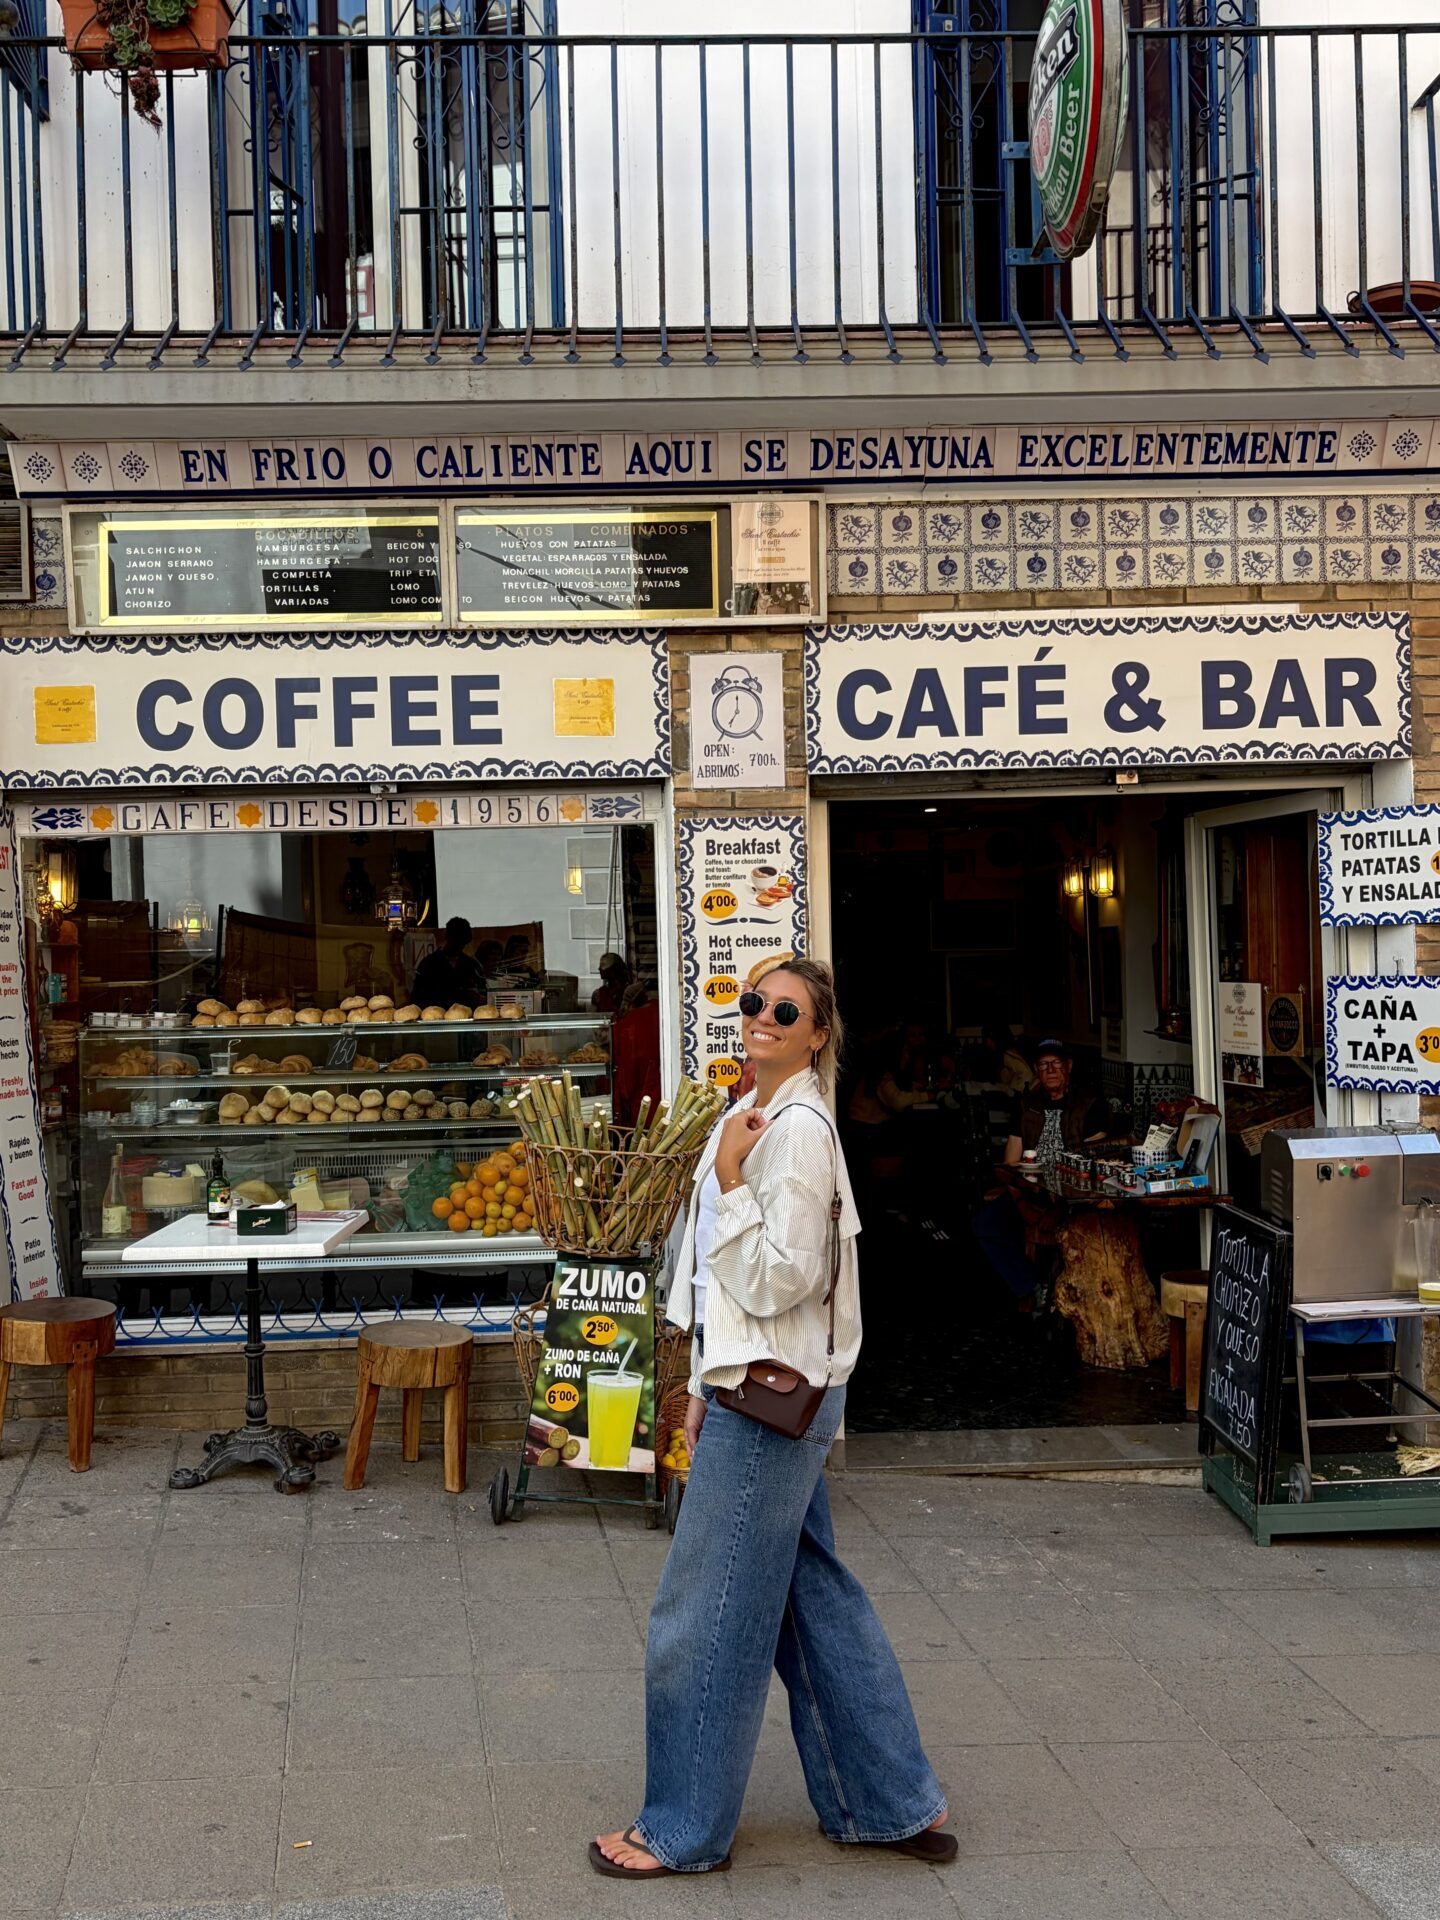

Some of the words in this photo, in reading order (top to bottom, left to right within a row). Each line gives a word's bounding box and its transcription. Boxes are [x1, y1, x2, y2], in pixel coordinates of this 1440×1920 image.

[1059, 82, 1080, 161] Beer
[184, 449, 228, 483] EN
[254, 447, 347, 481] FRIO
[370, 446, 392, 477] O
[416, 443, 602, 478] CALIENTE
[626, 440, 713, 474] AQUI
[743, 439, 787, 473] SE
[810, 436, 994, 471] DESAYUNA
[1018, 430, 1337, 468] EXCELENTEMENTE
[495, 526, 554, 537] PLATOS
[591, 524, 689, 535] COMBINADOS
[126, 546, 202, 555] SALCHICHON
[256, 543, 340, 553] HAMBURGESA
[386, 542, 425, 551] BEICON
[429, 542, 436, 550] Y
[500, 540, 544, 549] HUEVOS
[548, 540, 568, 549] CON
[573, 539, 617, 548] PATATAS
[256, 557, 341, 566] HAMBURGESA
[388, 556, 410, 564] HOT
[418, 555, 439, 564] DOG
[612, 553, 618, 561] Y
[620, 552, 668, 561] ENSALADA
[126, 560, 162, 569] JAMON
[167, 559, 214, 568] SERRANO
[125, 574, 163, 582] JAMON
[168, 573, 174, 581] Y
[272, 571, 332, 580] COMPLETA
[554, 567, 602, 576] MORCILLA
[604, 566, 644, 575] PATATAS
[646, 566, 653, 575] Y
[653, 566, 689, 574] HUEVOS
[260, 585, 320, 593] TORTILLAS
[390, 583, 420, 592] LOMO
[600, 581, 627, 589] LOMO
[632, 581, 639, 589] Y
[642, 580, 681, 588] PATATAS
[125, 587, 155, 596] ATUN
[124, 600, 172, 609] CHORIZO
[274, 598, 329, 606] VARIADAS
[391, 597, 418, 605] LOMO
[504, 596, 543, 604] BEICON
[550, 594, 591, 603] HUEVOS
[597, 594, 605, 603] Y
[608, 594, 651, 602] PATATAS
[836, 646, 1069, 741] CAFÉ
[1103, 661, 1167, 734] &
[1201, 657, 1382, 730] BAR
[136, 674, 503, 752] COFFEE
[703, 744, 735, 758] OPEN:
[697, 764, 744, 778] ABRIMOS:
[122, 800, 232, 832] CAFE
[268, 798, 409, 829] DESDE
[448, 795, 552, 827] 1956
[1340, 827, 1431, 851] TORTILLA
[705, 838, 781, 856] Breakfast
[741, 857, 767, 865] chocolate
[1341, 855, 1421, 877] PATATAS
[705, 873, 722, 881] Butter
[1341, 885, 1353, 903] Y
[708, 934, 732, 948] Hot
[735, 934, 782, 947] cheese
[709, 948, 733, 961] and
[709, 961, 737, 975] ham
[3, 986, 19, 997] price
[1344, 995, 1418, 1021] CAÑA
[706, 1022, 740, 1039] Eggs,
[706, 1040, 729, 1054] and
[1347, 1040, 1415, 1064] TAPA
[0, 1050, 20, 1060] hecho
[16, 1087, 30, 1097] food
[14, 1149, 33, 1160] bueno
[11, 1180, 26, 1191] Fast
[26, 1176, 38, 1186] and
[18, 1189, 35, 1201] Good
[24, 1238, 41, 1250] Patio
[23, 1249, 46, 1264] interior
[1218, 1228, 1270, 1292] TORTILLA
[29, 1276, 48, 1290] Inside
[558, 1267, 647, 1300] ZUMO
[1214, 1270, 1261, 1327] CHORIZO
[556, 1299, 570, 1310] DE
[571, 1299, 599, 1312] CAÑA
[601, 1303, 647, 1315] NATURAL
[1217, 1318, 1224, 1345] Y
[1225, 1324, 1260, 1363] QUESO
[545, 1348, 574, 1361] ZUMO
[577, 1350, 591, 1362] DE
[592, 1350, 620, 1364] CAÑA
[554, 1364, 582, 1379] RON
[1208, 1367, 1256, 1429] ENSALADA
